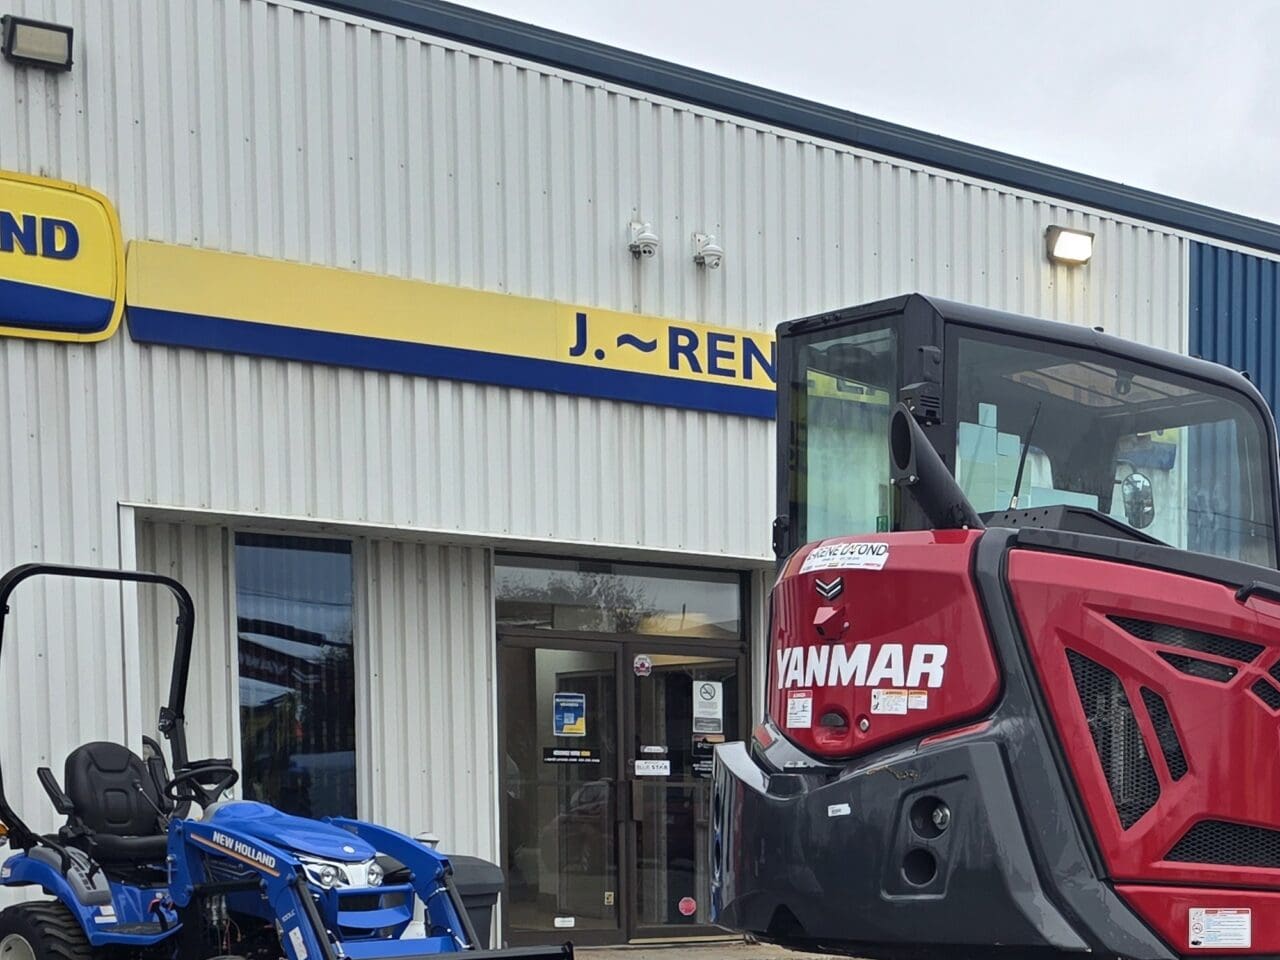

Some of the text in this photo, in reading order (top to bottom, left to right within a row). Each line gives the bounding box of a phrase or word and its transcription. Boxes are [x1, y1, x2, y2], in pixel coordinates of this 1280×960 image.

[777, 643, 948, 690] YANMAR
[212, 830, 276, 869] NEW HOLLAND
